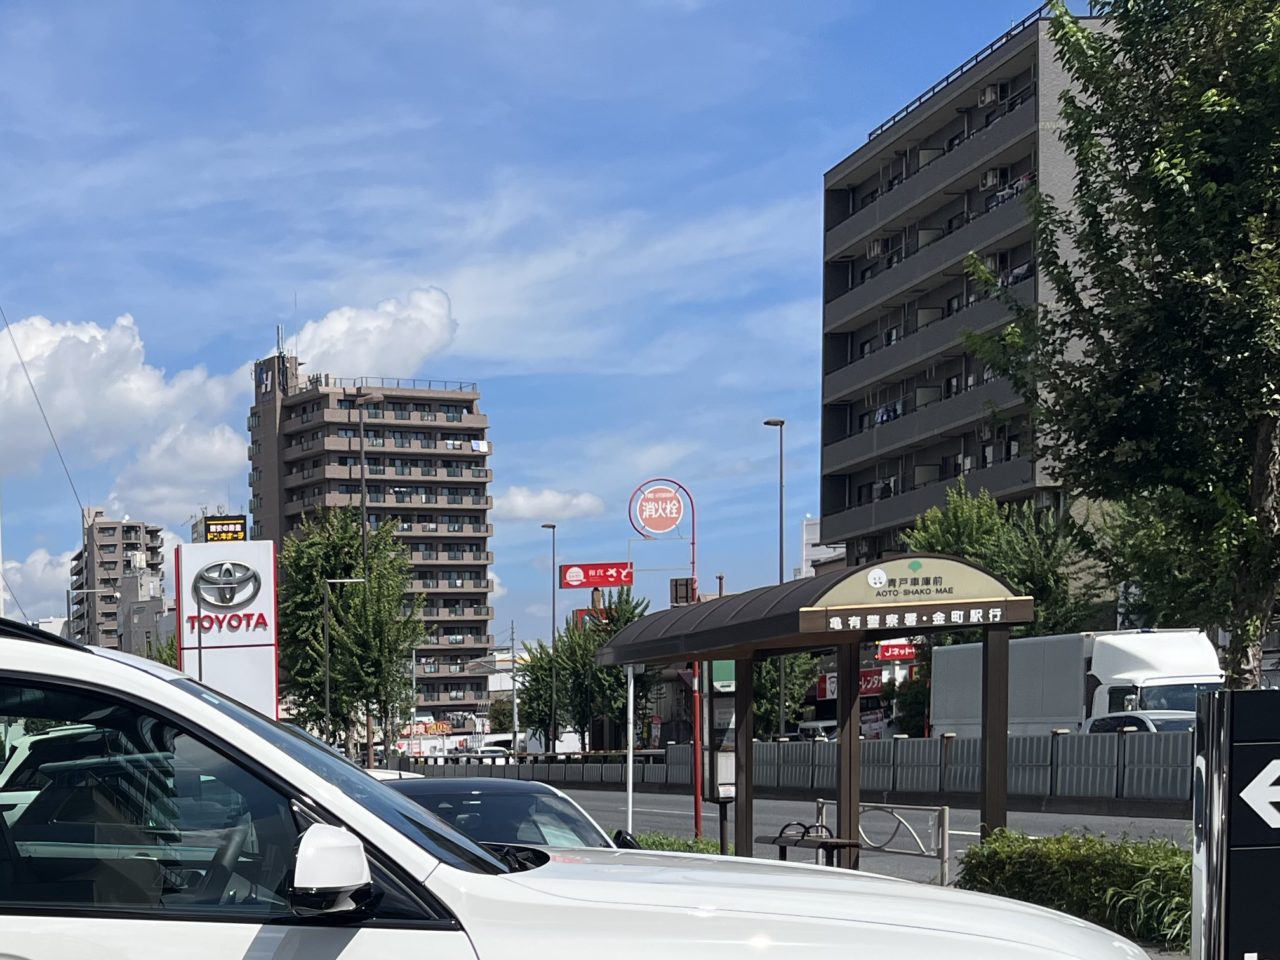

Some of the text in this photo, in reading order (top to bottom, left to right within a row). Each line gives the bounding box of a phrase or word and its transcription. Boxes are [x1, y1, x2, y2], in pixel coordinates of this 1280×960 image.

[642, 500, 679, 519] 消火栓
[888, 576, 943, 588] 青戸車庫前
[187, 612, 269, 633] TOYOTA
[859, 675, 882, 690] レンタ
